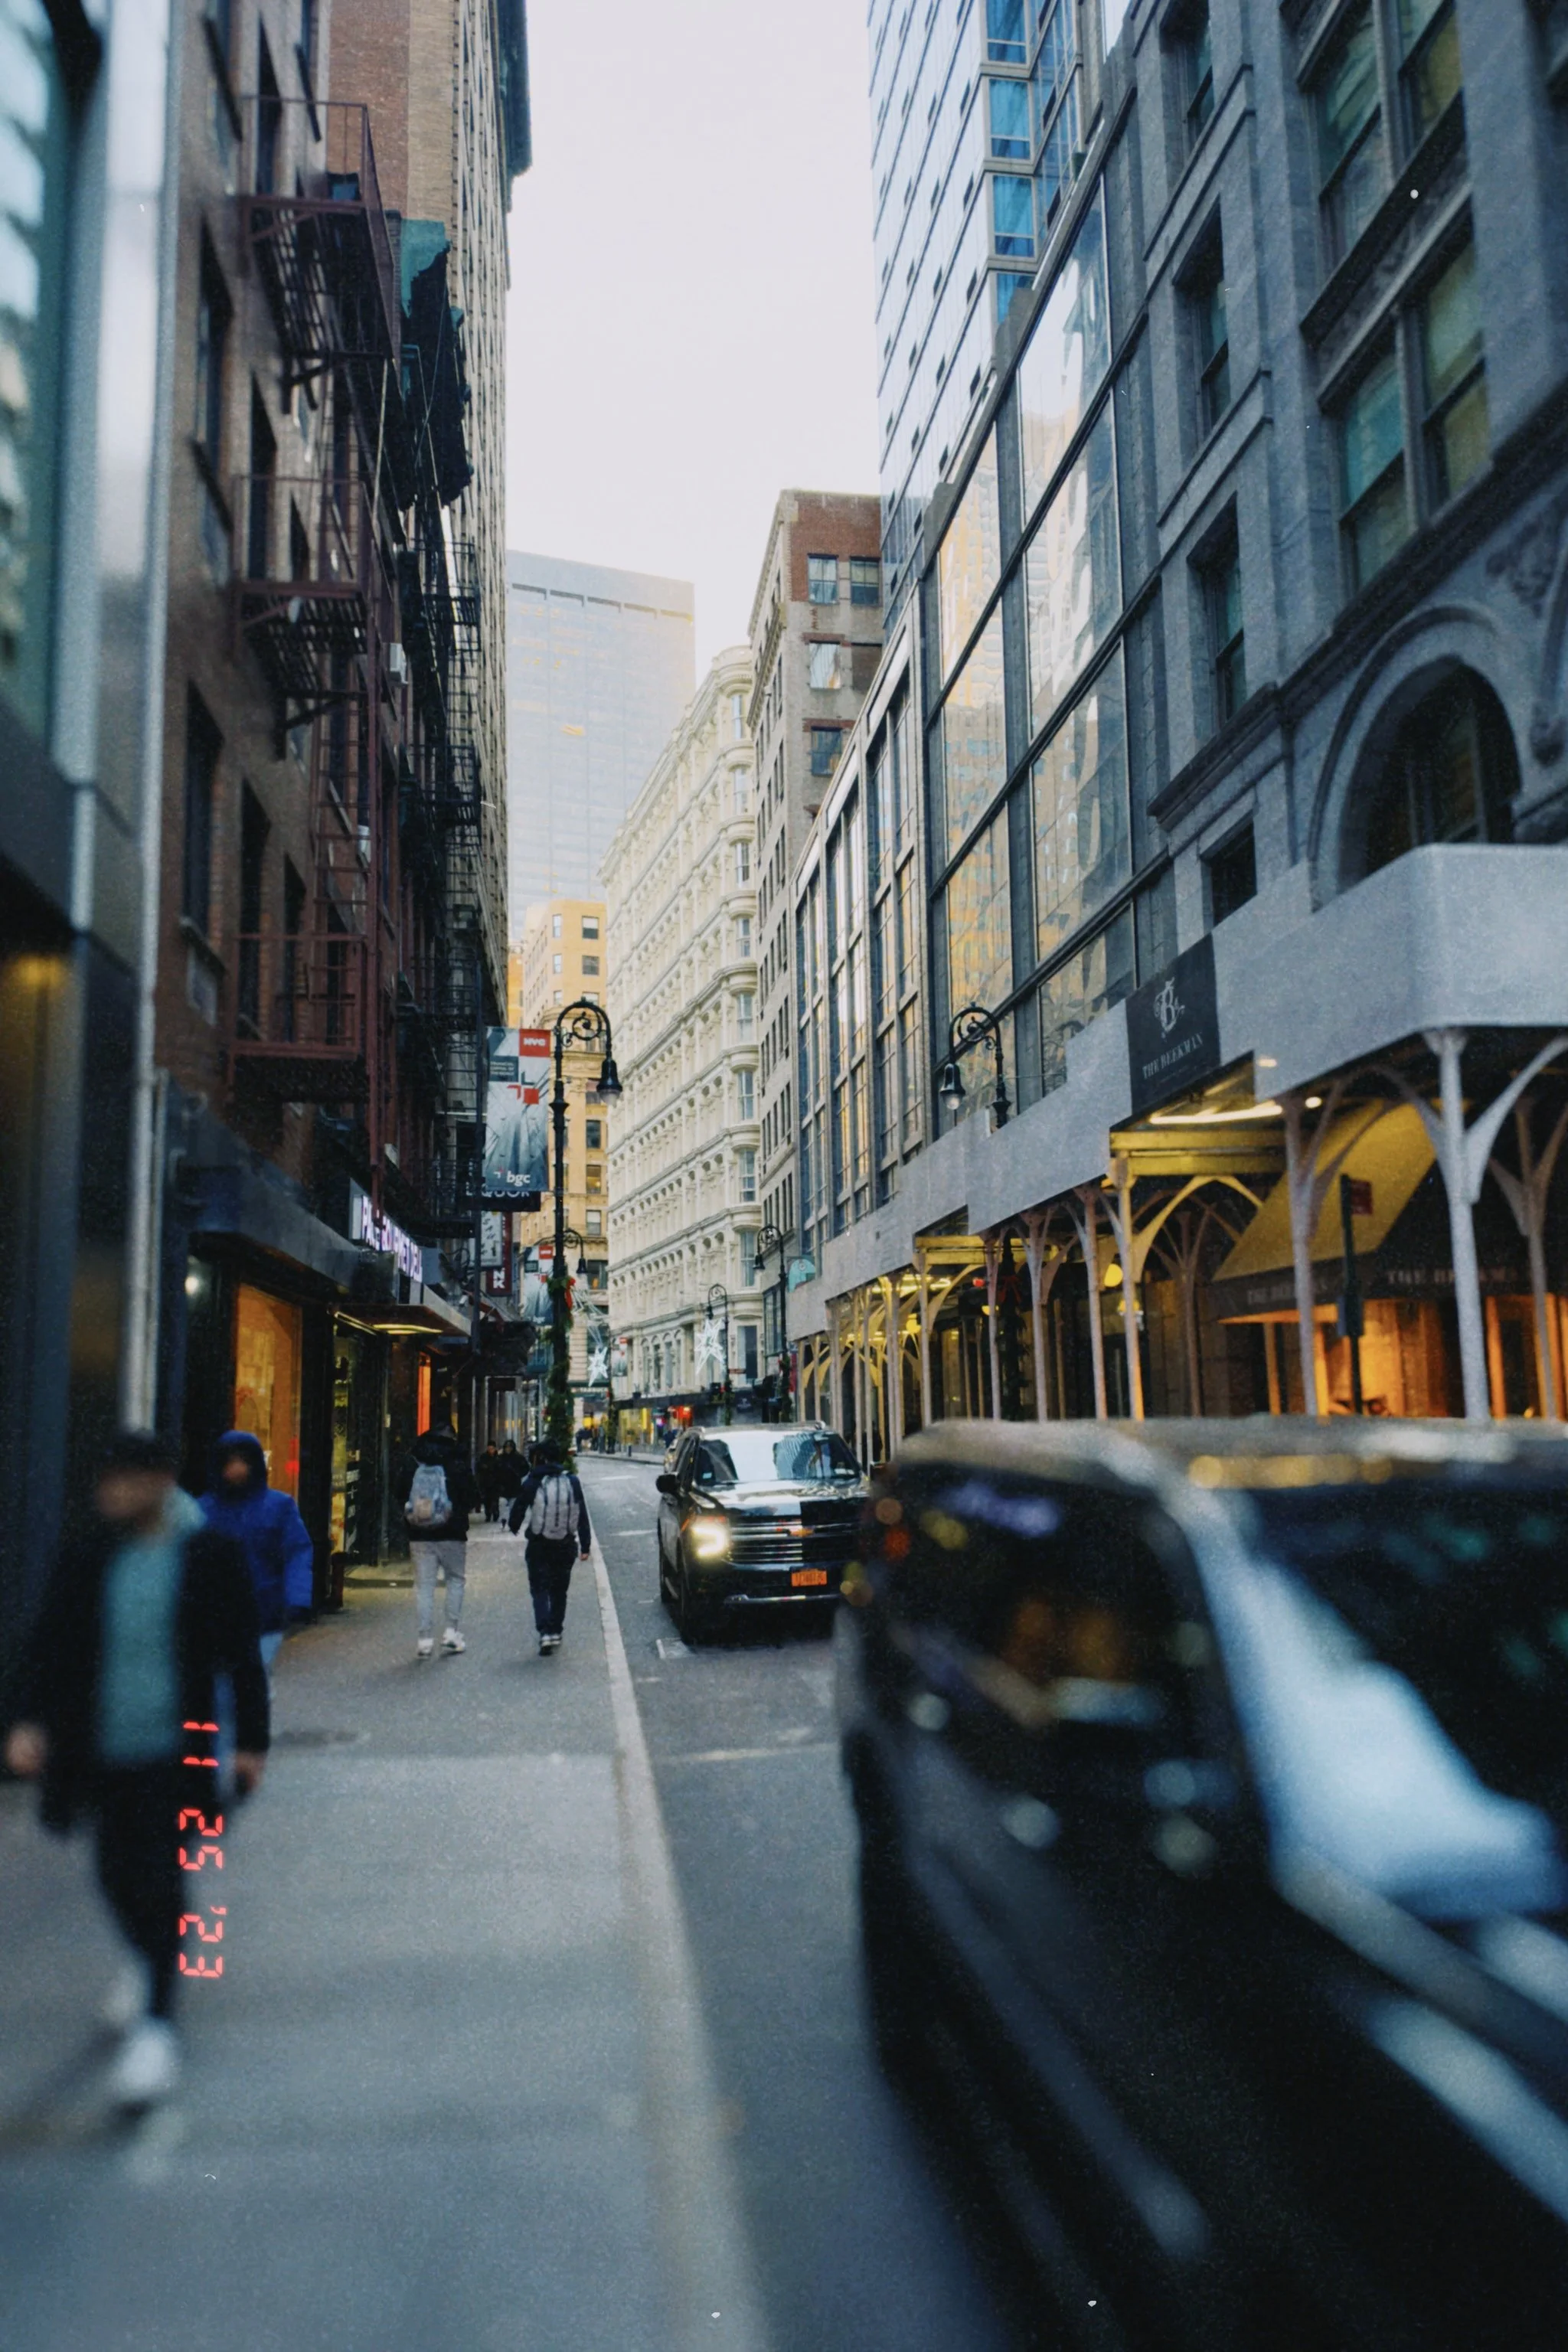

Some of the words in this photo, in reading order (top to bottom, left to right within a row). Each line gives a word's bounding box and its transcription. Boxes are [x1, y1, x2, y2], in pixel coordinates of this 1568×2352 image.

[1142, 1058, 1161, 1080] THE
[1161, 1033, 1204, 1070] BEEKMAN
[506, 1170, 531, 1187] bgc
